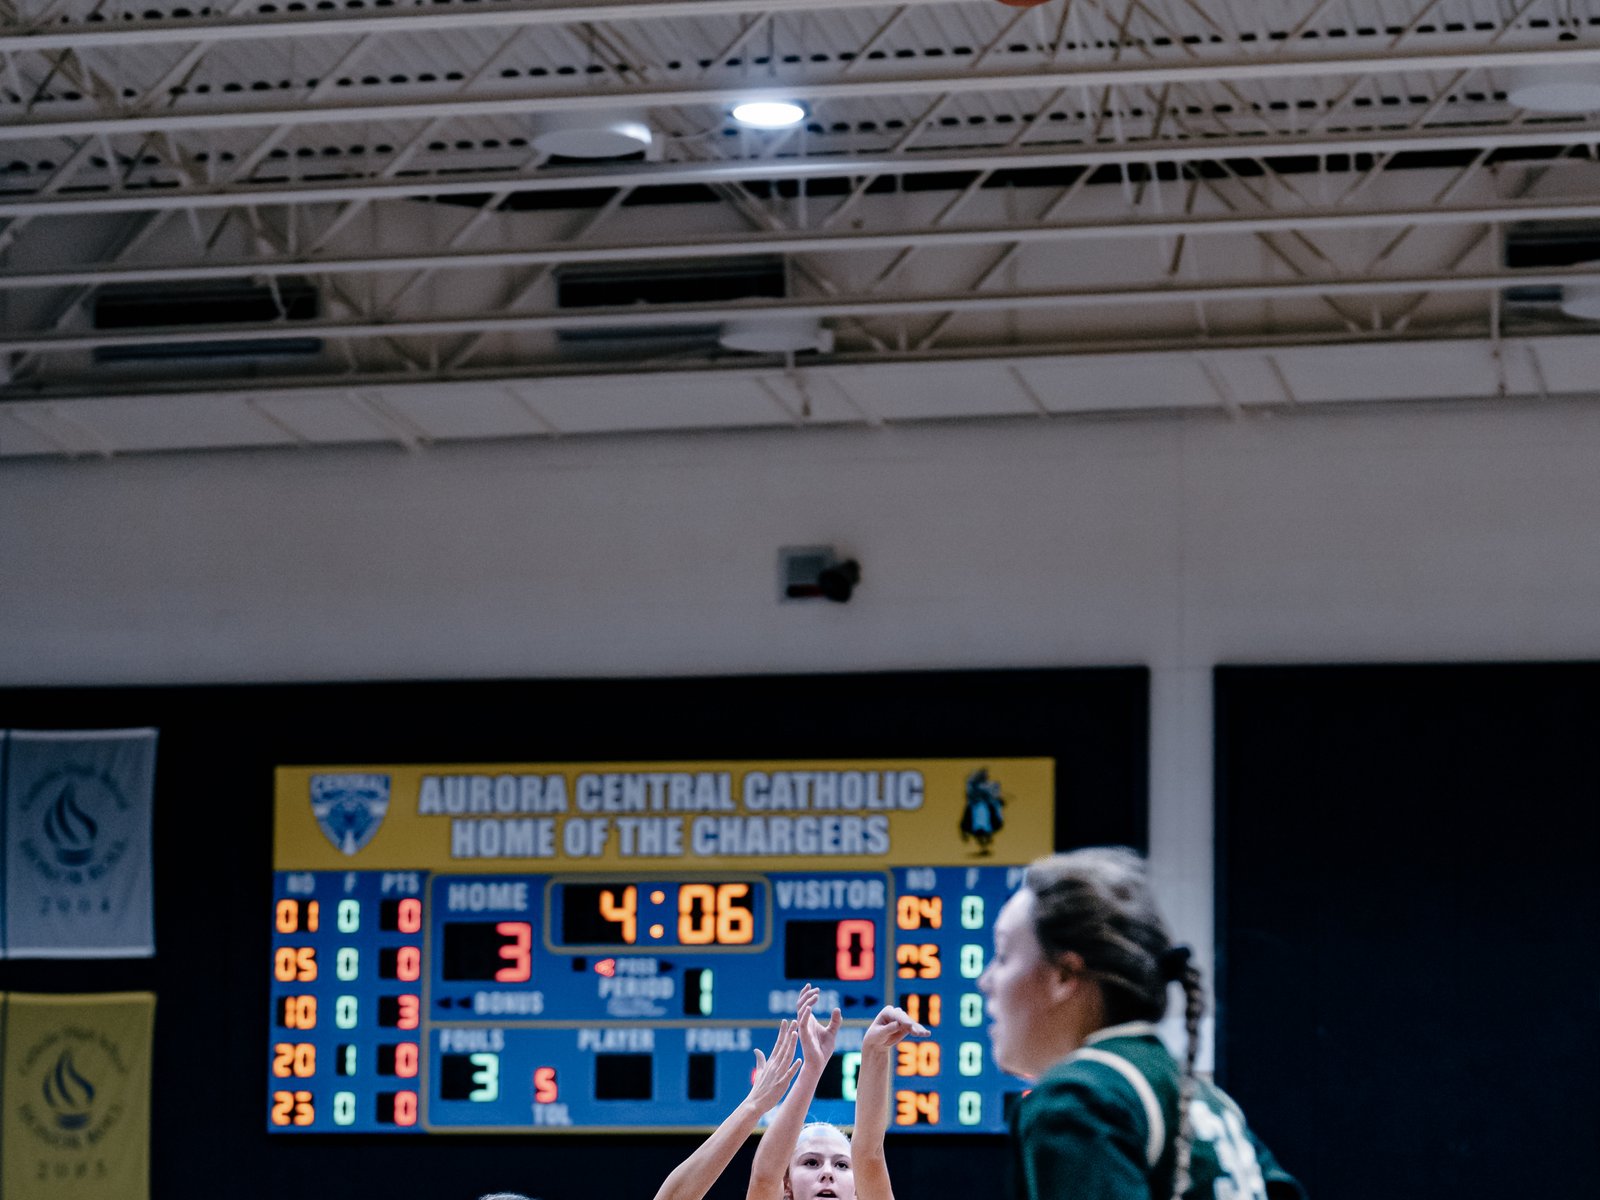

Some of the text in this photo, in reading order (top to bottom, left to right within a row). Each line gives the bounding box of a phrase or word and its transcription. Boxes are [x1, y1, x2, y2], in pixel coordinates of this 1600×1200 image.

[419, 770, 924, 815] AURORA CENTRAL CATHOLIC
[450, 815, 890, 858] HOME OF THE CHARGERS
[381, 873, 420, 894] PTS
[448, 882, 528, 911] HOME
[775, 880, 886, 909] VISITOR
[276, 898, 422, 933] 01 0 0
[897, 895, 984, 930] 04 0
[274, 946, 421, 982] 05 0 0
[495, 921, 532, 982] 3
[836, 920, 876, 981] 0
[960, 943, 984, 979] 0
[474, 991, 544, 1015] BONUS
[598, 976, 674, 999] PERIOD
[699, 968, 713, 1016] 1
[768, 990, 840, 1014] BOUS
[284, 995, 420, 1030] 10 0 3
[907, 993, 983, 1027] 11 0
[440, 1029, 504, 1052] FOULS
[578, 1029, 654, 1050] PLAYER
[686, 1029, 751, 1051] FOULS
[272, 1043, 419, 1078] 20 1 0
[897, 1041, 982, 1077] 30 0
[469, 1053, 500, 1102] 3
[333, 1091, 356, 1126] 0
[394, 1090, 418, 1126] 0
[896, 1090, 981, 1125] 34 0
